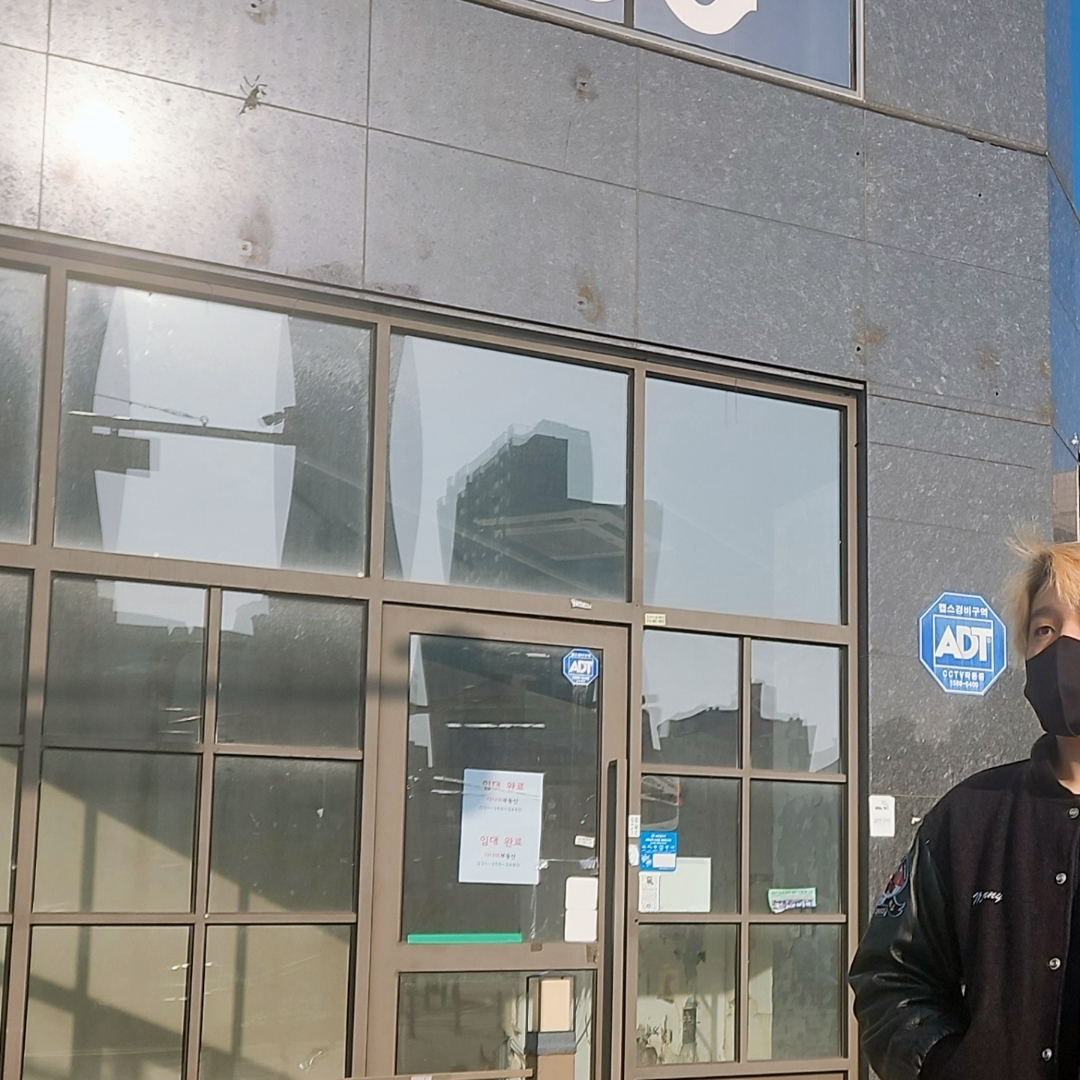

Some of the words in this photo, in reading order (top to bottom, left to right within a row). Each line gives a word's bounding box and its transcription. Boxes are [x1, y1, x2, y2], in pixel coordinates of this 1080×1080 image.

[935, 624, 992, 662] ADT
[568, 659, 594, 675] ADT
[482, 780, 501, 791] 임대
[480, 836, 499, 846] 임대
[504, 837, 523, 848] 완료
